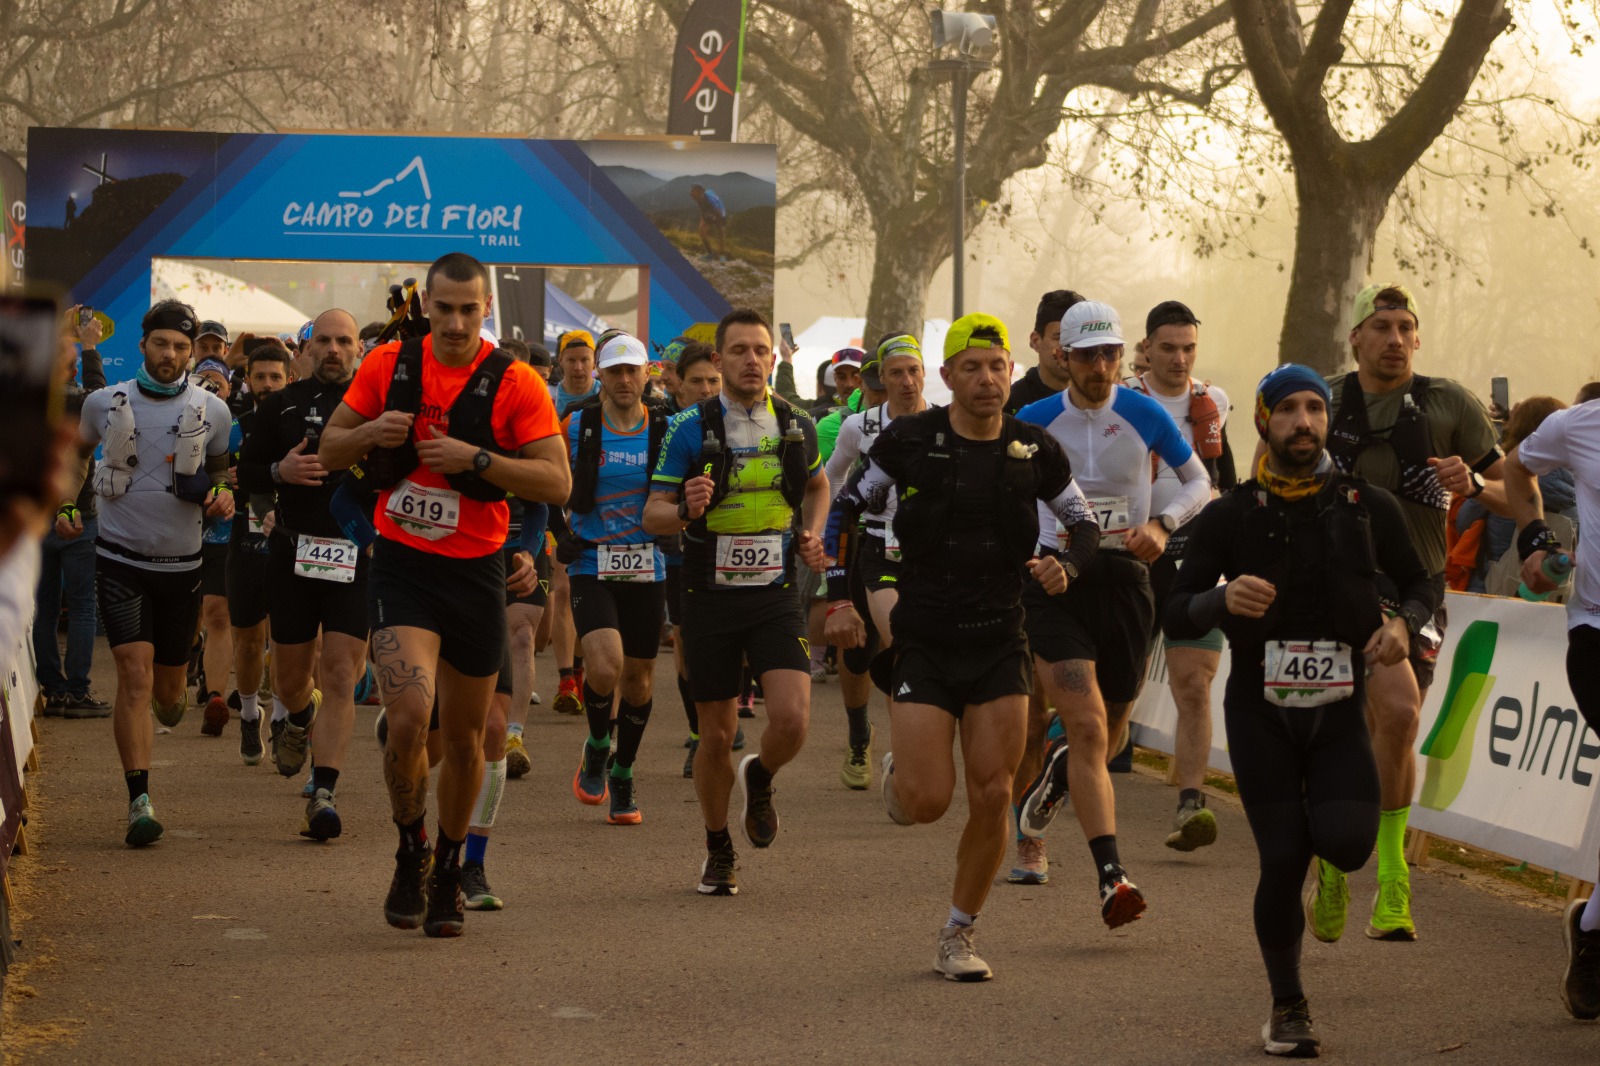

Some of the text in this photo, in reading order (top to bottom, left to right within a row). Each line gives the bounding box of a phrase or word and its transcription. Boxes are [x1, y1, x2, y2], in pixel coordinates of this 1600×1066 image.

[283, 201, 523, 231] CAMPO DEI FIORI
[479, 234, 522, 247] TRAIL
[1080, 321, 1113, 334] FUGA
[656, 444, 669, 472] FAST
[671, 408, 699, 433] LIGHT
[401, 495, 443, 521] 619
[309, 546, 345, 563] 442
[610, 553, 643, 570] 502
[731, 547, 769, 567] 592
[1284, 656, 1334, 681] 462
